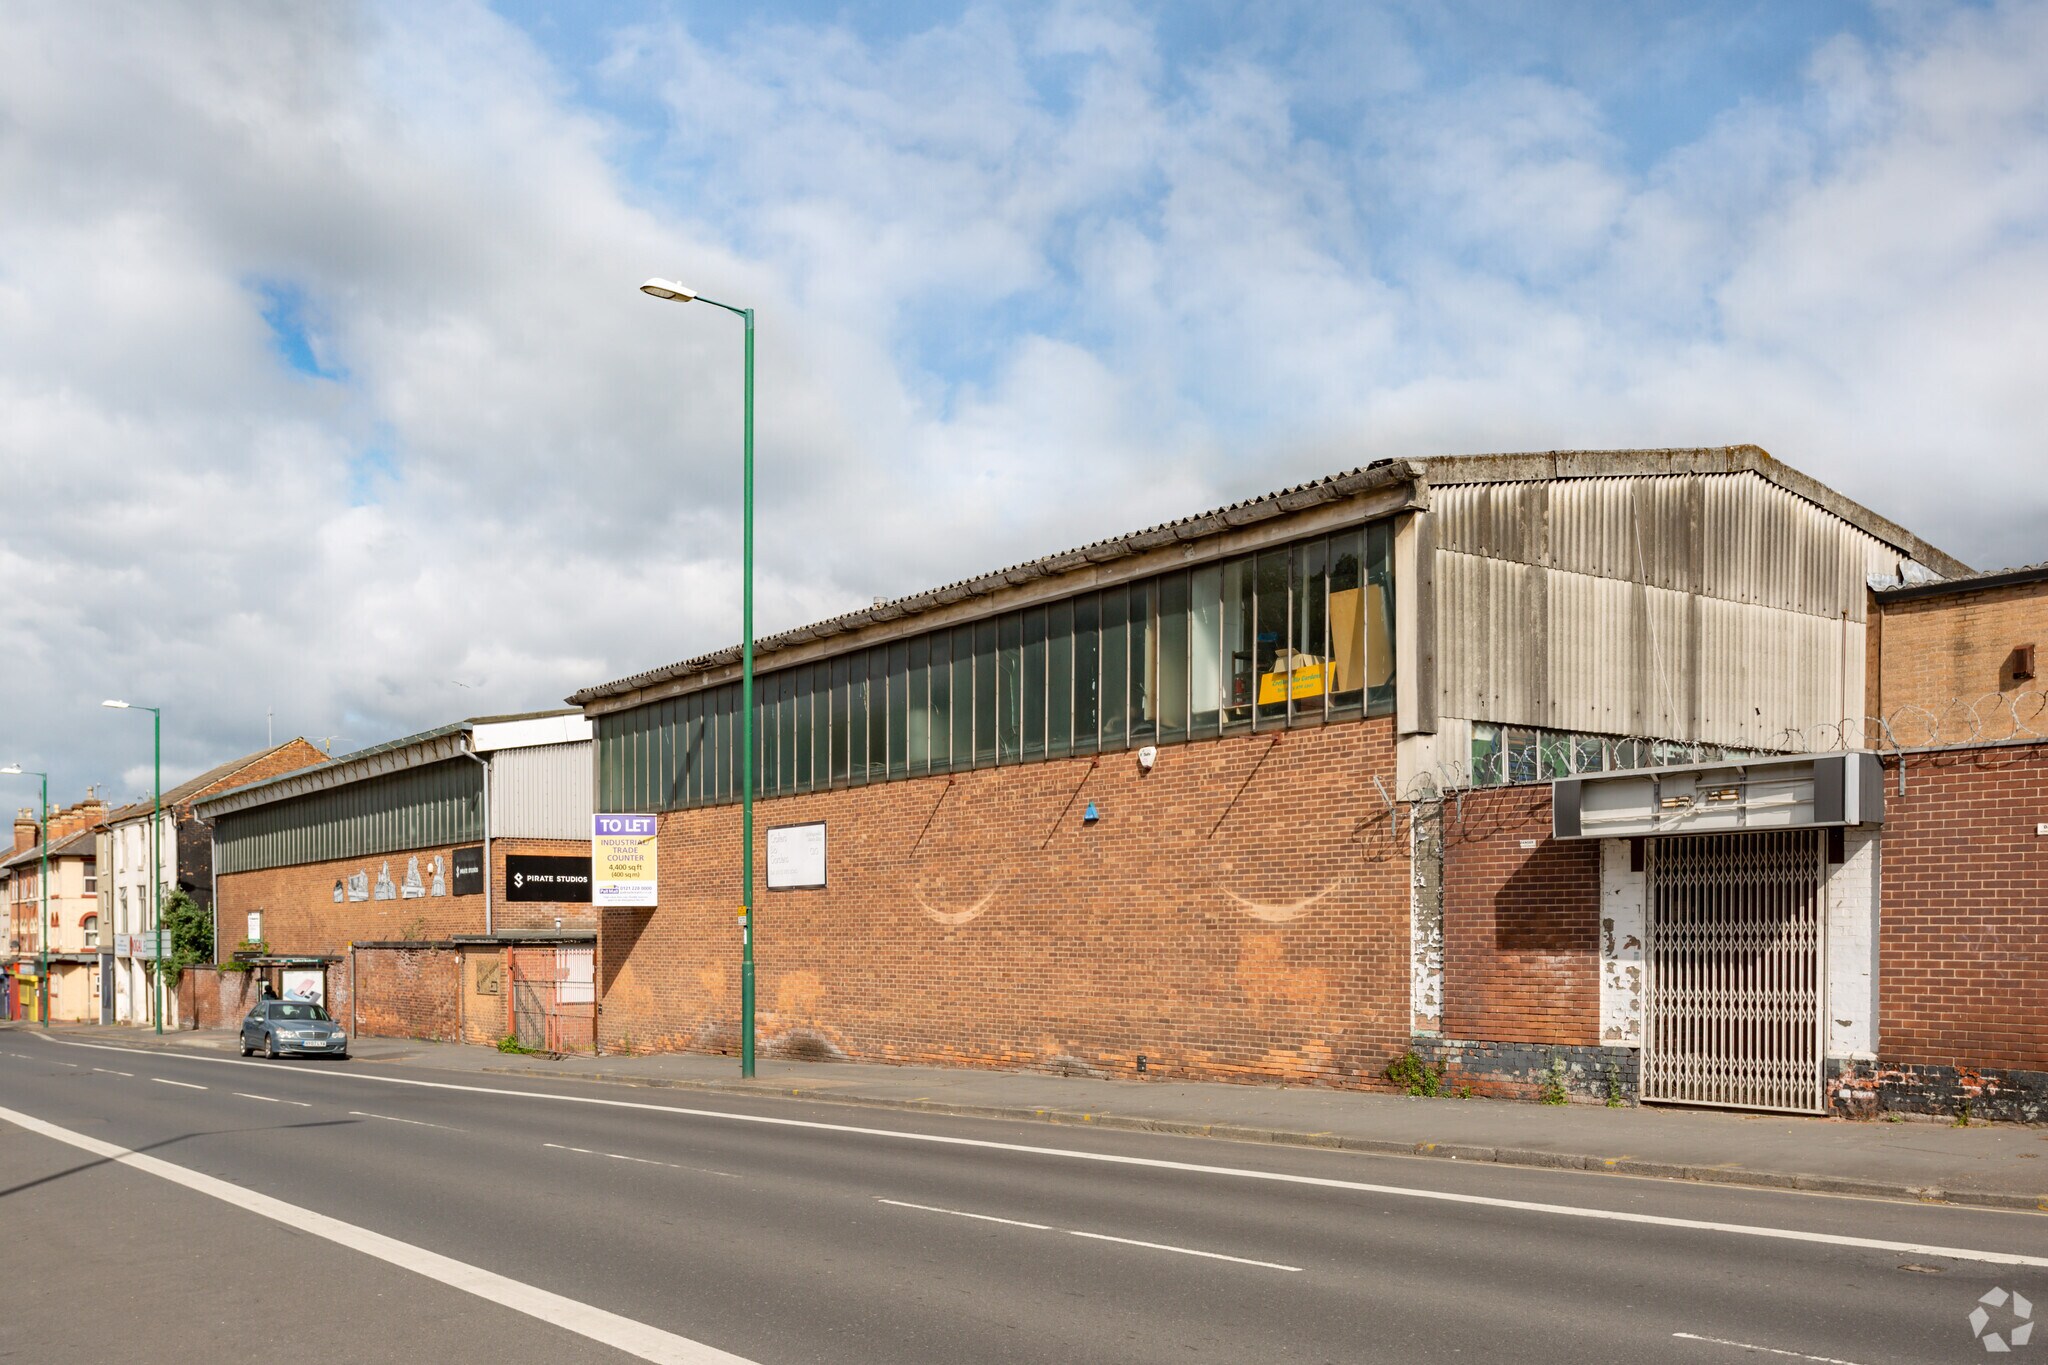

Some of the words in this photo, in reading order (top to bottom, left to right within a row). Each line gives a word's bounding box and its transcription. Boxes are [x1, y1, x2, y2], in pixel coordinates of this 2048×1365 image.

[600, 819, 621, 832] TO
[625, 819, 650, 832] LET
[556, 875, 588, 883] STUDIOS
